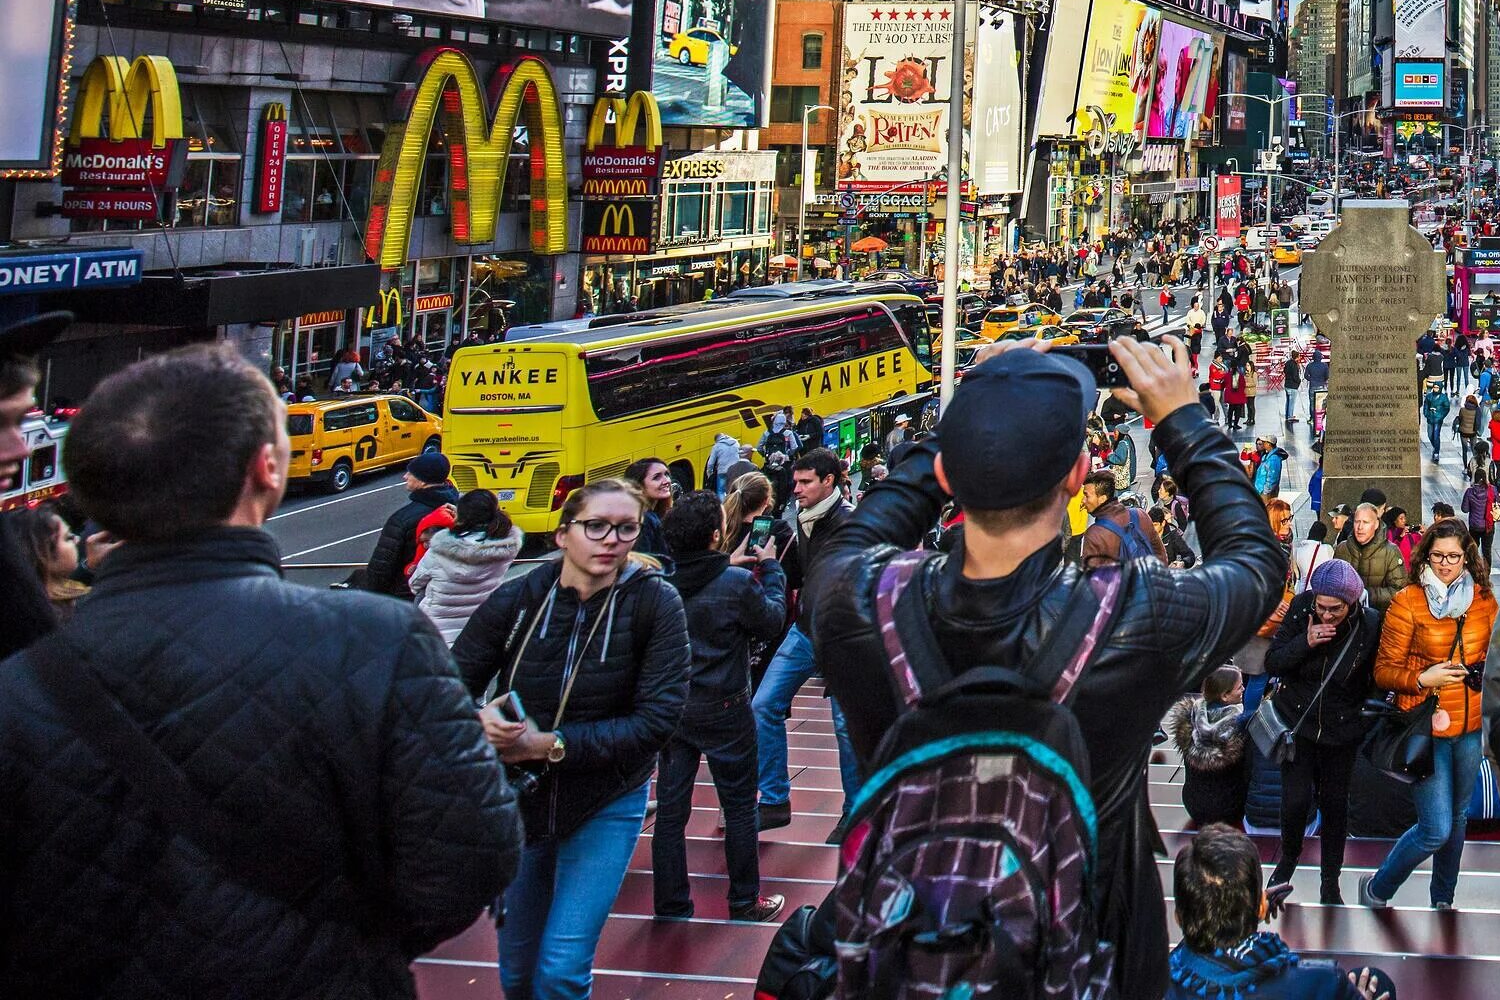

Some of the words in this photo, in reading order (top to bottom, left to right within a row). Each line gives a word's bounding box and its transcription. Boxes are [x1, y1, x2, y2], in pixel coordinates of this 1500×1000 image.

[203, 0, 245, 8] SPECTACOLOR
[853, 22, 871, 31] THE
[874, 22, 923, 31] FUNNIEST
[868, 33, 881, 44] IN
[885, 33, 907, 44] 400
[1091, 40, 1113, 73] LION
[878, 113, 932, 123] SOMETHING
[985, 105, 1011, 137] CATS
[273, 125, 281, 157] OPEN
[65, 153, 164, 170] McDonald's
[585, 156, 655, 166] McDonald's
[663, 160, 725, 178] EXPRESS
[79, 171, 146, 181] Restaurant
[268, 169, 277, 207] HOURS
[64, 201, 94, 210] OPEN
[97, 201, 111, 210] 24
[114, 201, 152, 210] HOURS
[1218, 193, 1241, 209] JERSEY
[1220, 207, 1237, 219] BOYS
[84, 258, 137, 280] ATM
[652, 264, 680, 275] EXPRESS
[692, 262, 717, 270] EXPRESS
[1330, 274, 1372, 283] FRANCIS
[1384, 274, 1418, 283] DUFFY
[461, 368, 558, 386] YANKEE
[802, 351, 902, 398] YANKEE
[480, 393, 516, 402] BOSTON,
[401, 431, 412, 439] NYC
[473, 435, 540, 444] www.yankeeline.us
[359, 441, 374, 461] T
